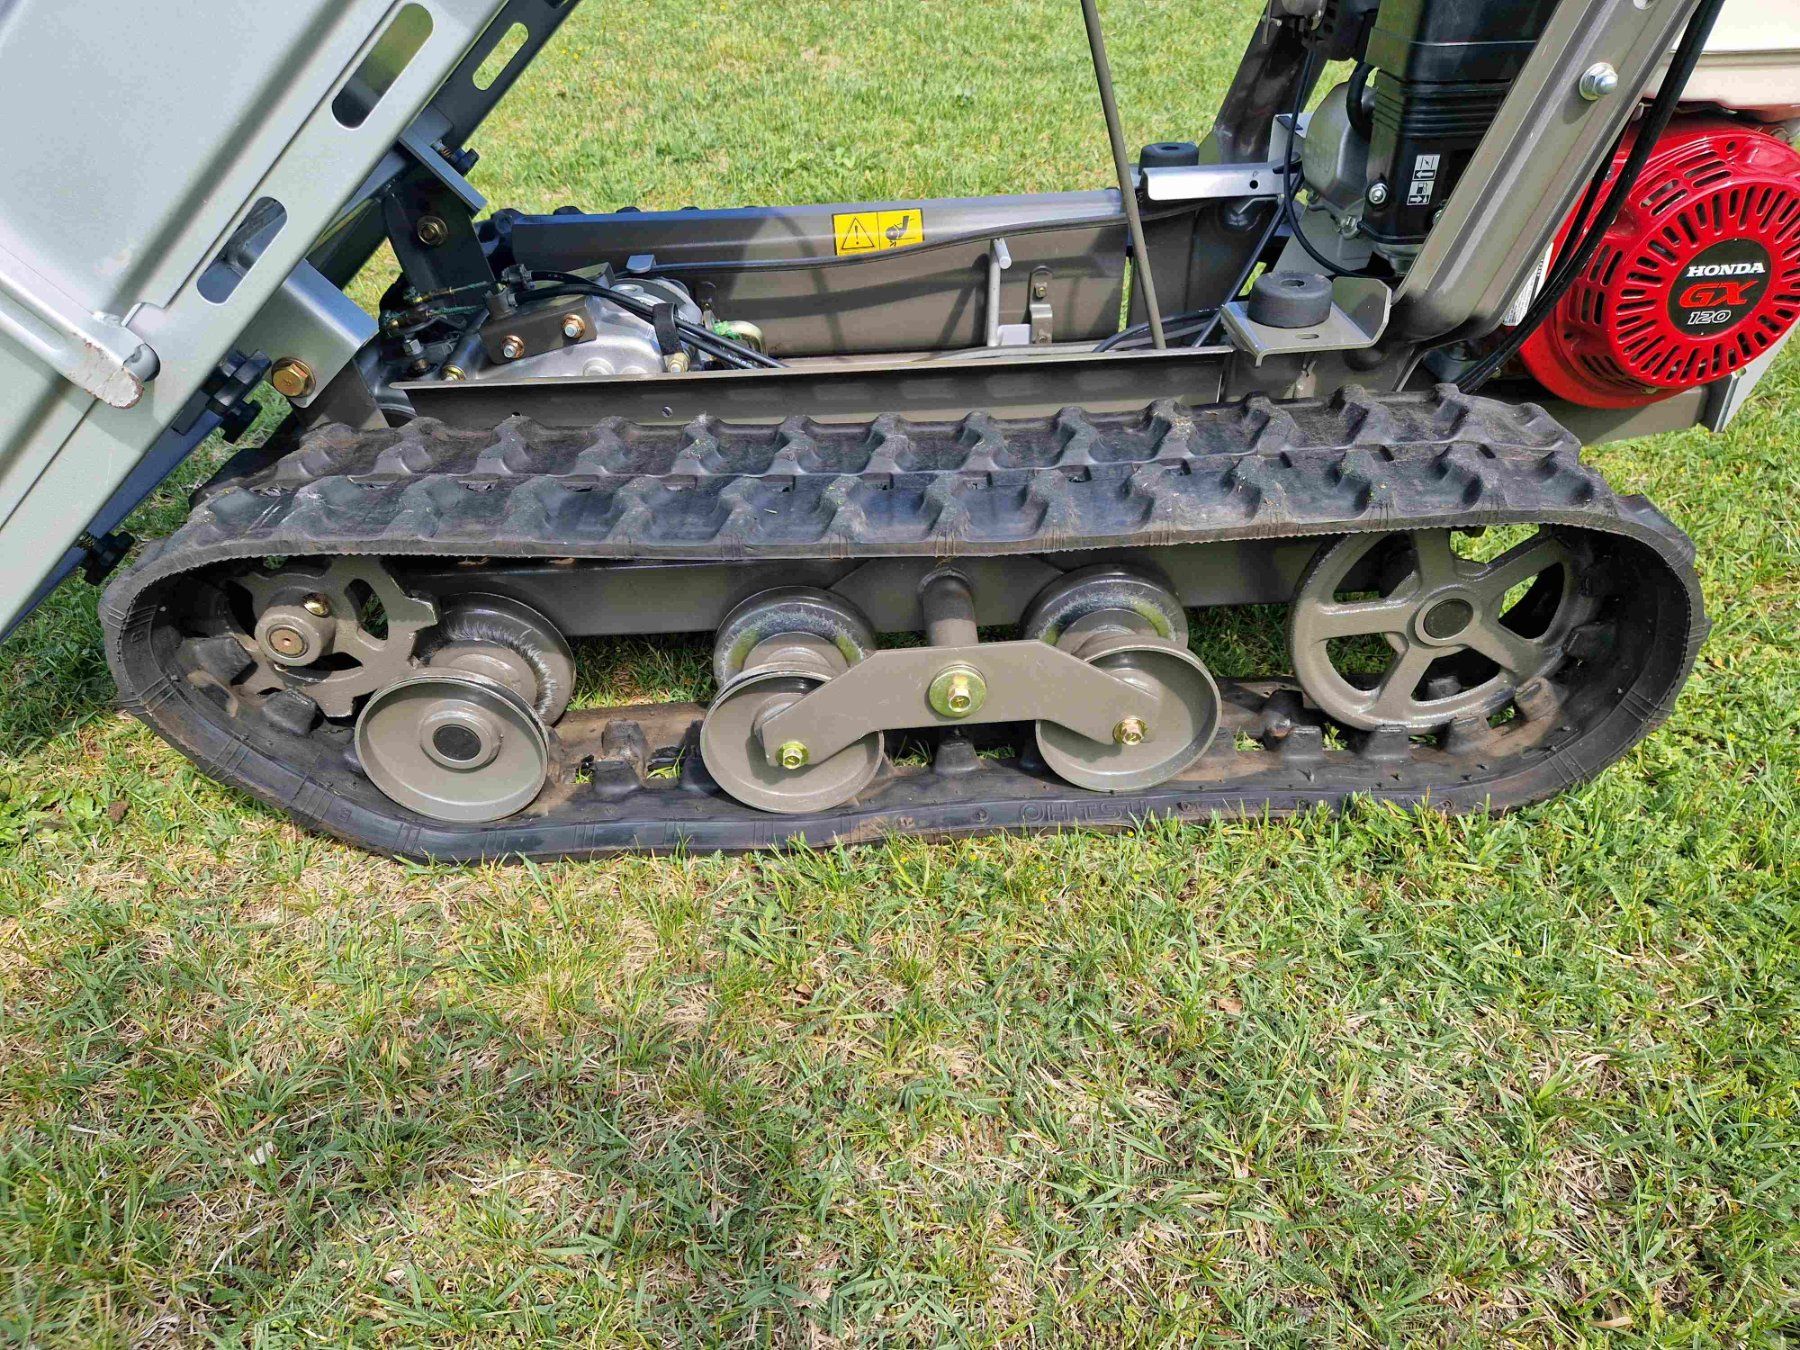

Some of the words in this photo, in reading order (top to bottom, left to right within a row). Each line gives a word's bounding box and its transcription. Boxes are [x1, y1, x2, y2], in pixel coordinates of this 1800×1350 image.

[1685, 262, 1766, 278] HONDA
[1679, 280, 1759, 308] GX
[1687, 309, 1732, 325] 120
